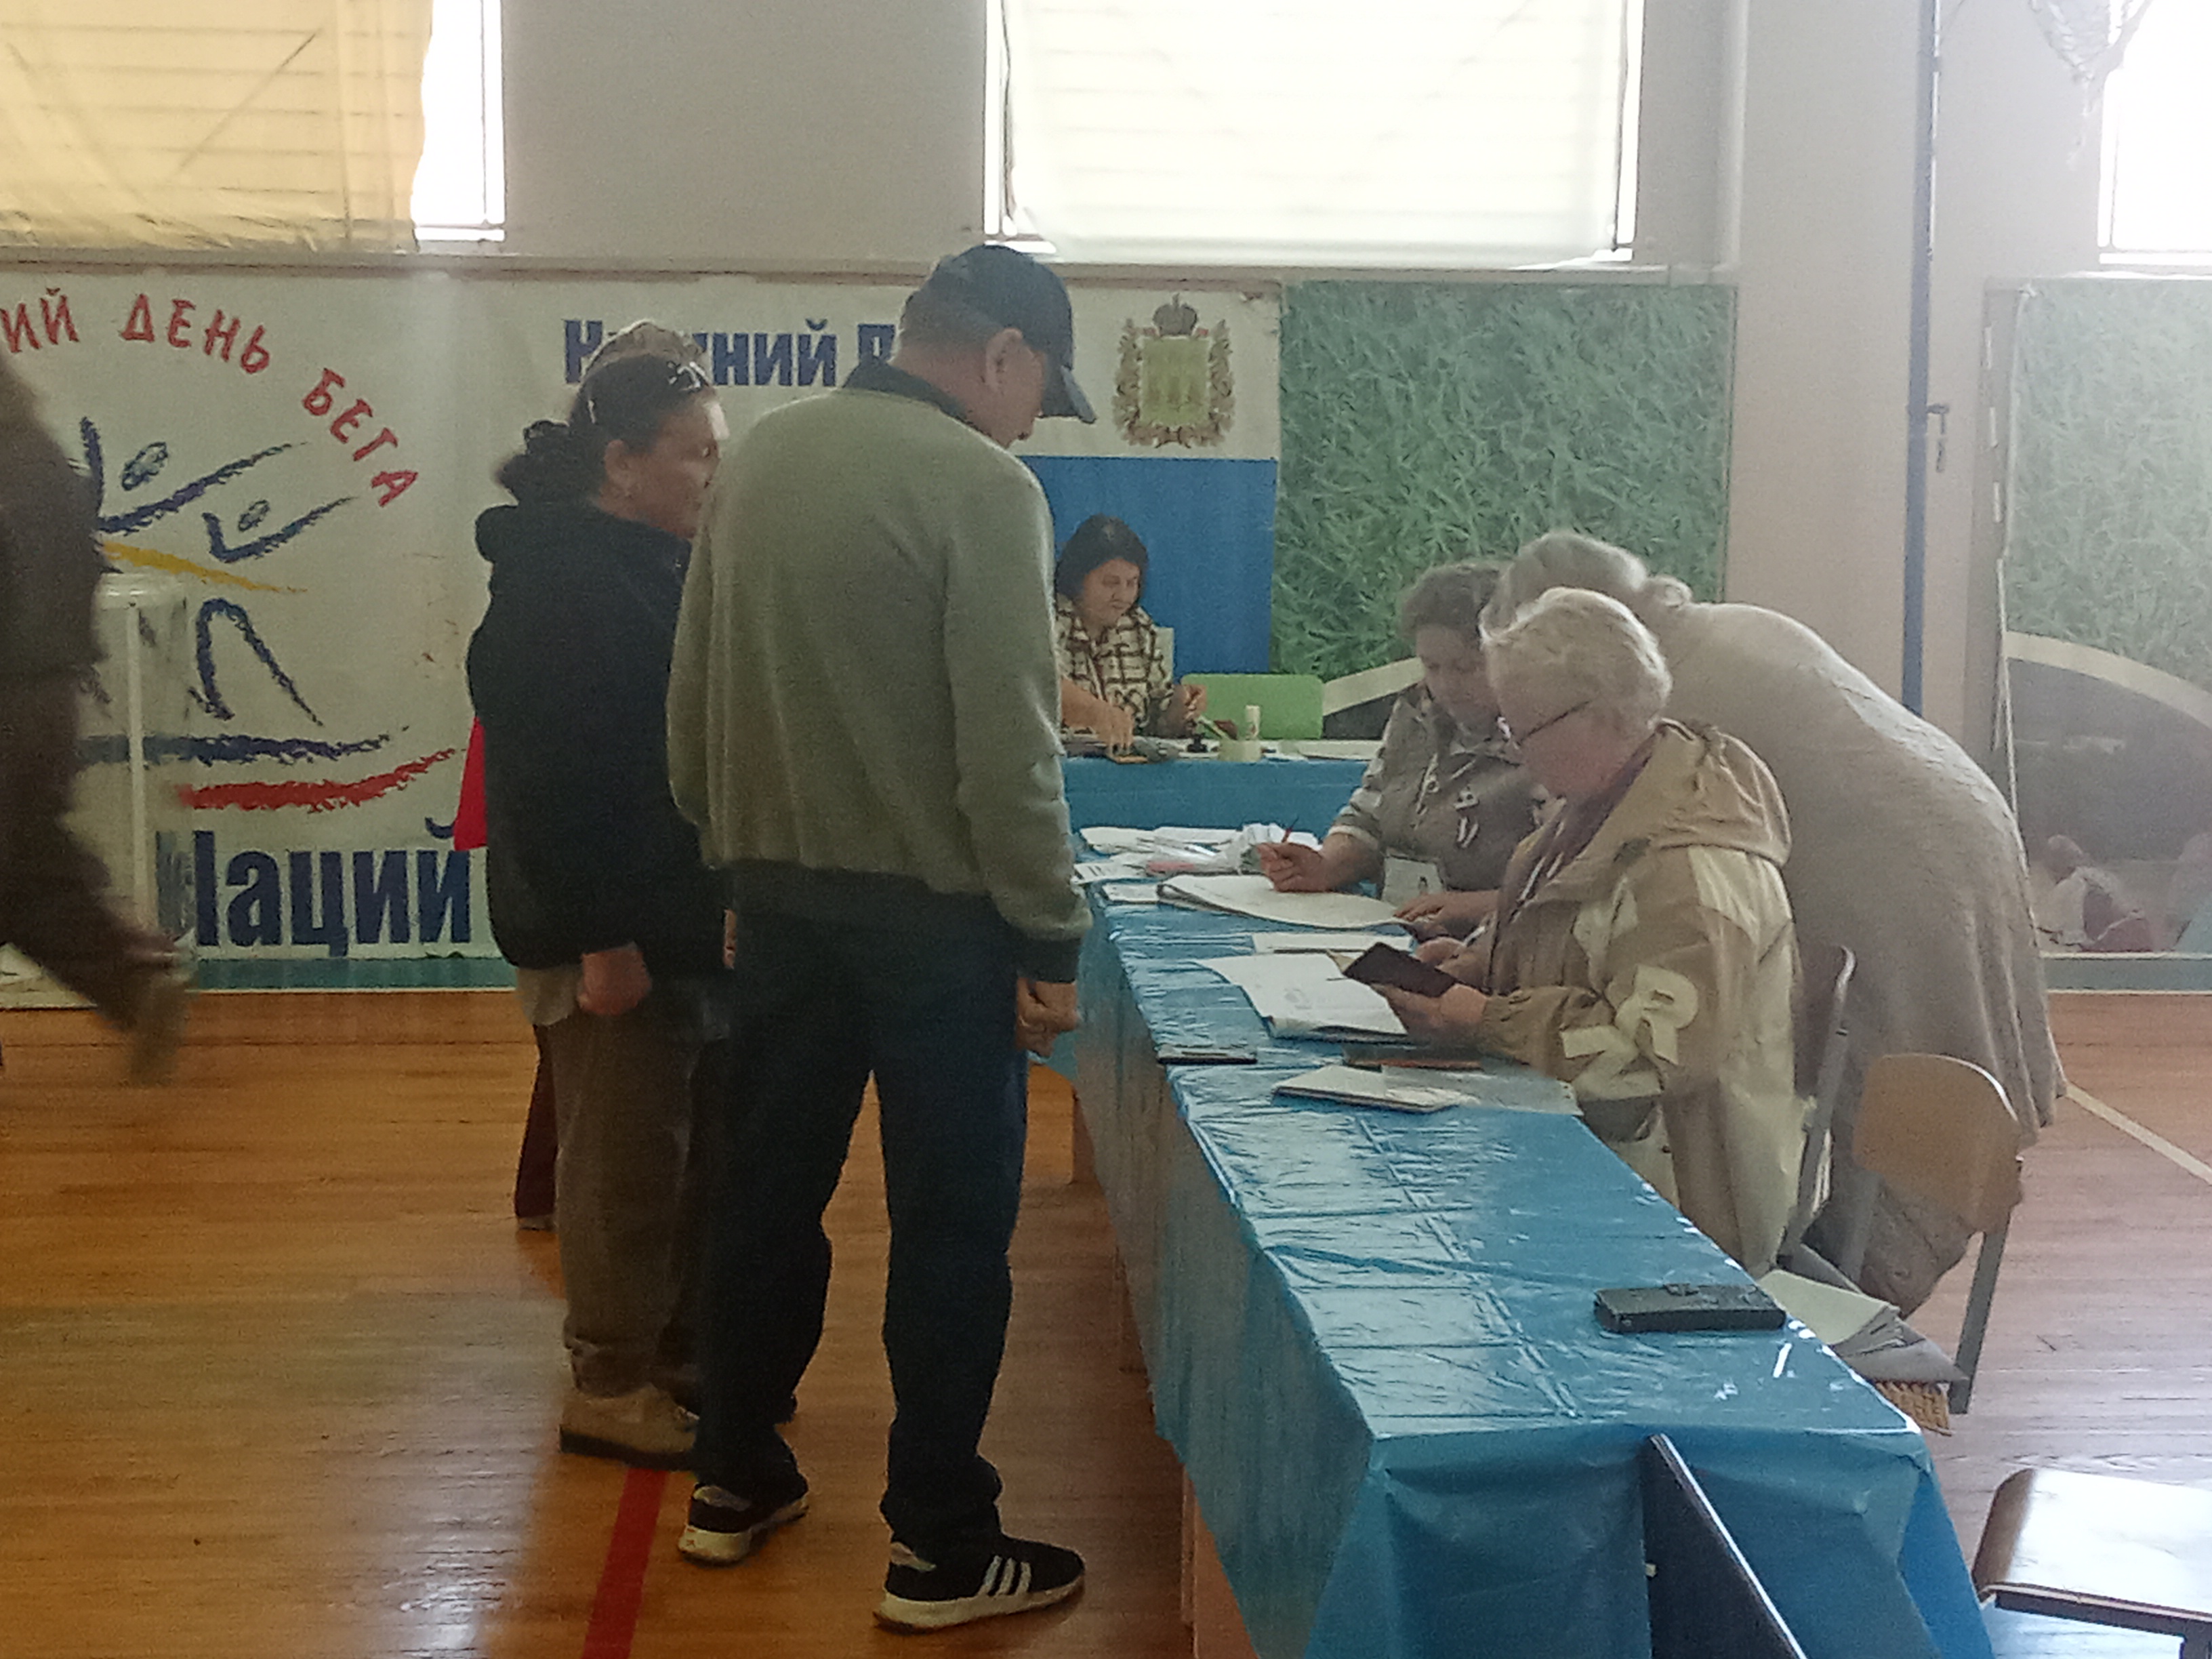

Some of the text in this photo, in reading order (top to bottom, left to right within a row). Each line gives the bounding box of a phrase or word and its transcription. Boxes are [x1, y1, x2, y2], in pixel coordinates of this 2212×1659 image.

[0, 287, 418, 507] ИЙ ДЕНЬ БЕГА
[564, 319, 837, 387] Нний
